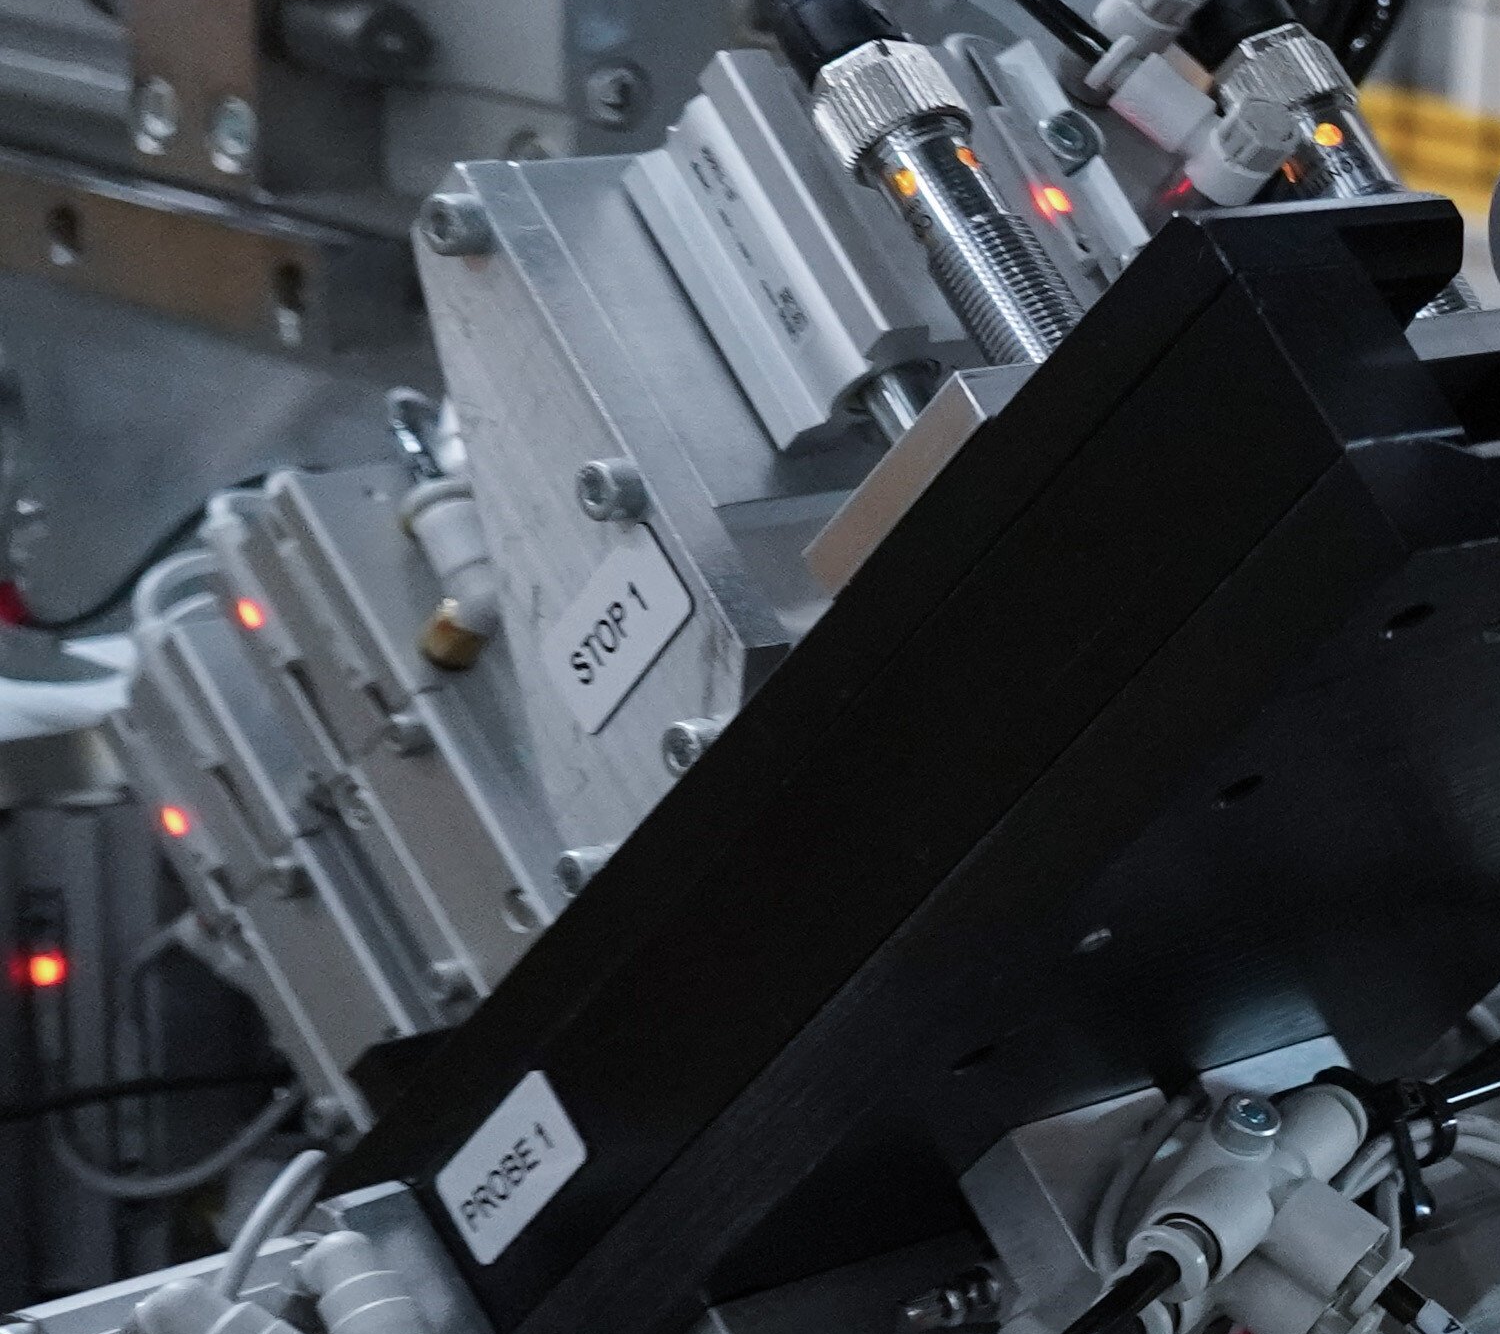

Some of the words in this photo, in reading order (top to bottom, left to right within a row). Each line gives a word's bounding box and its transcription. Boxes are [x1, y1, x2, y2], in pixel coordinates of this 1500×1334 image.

[570, 601, 629, 685] STOP
[627, 581, 649, 611] 1
[461, 1136, 542, 1234] PROBE
[532, 1121, 556, 1149] 1
